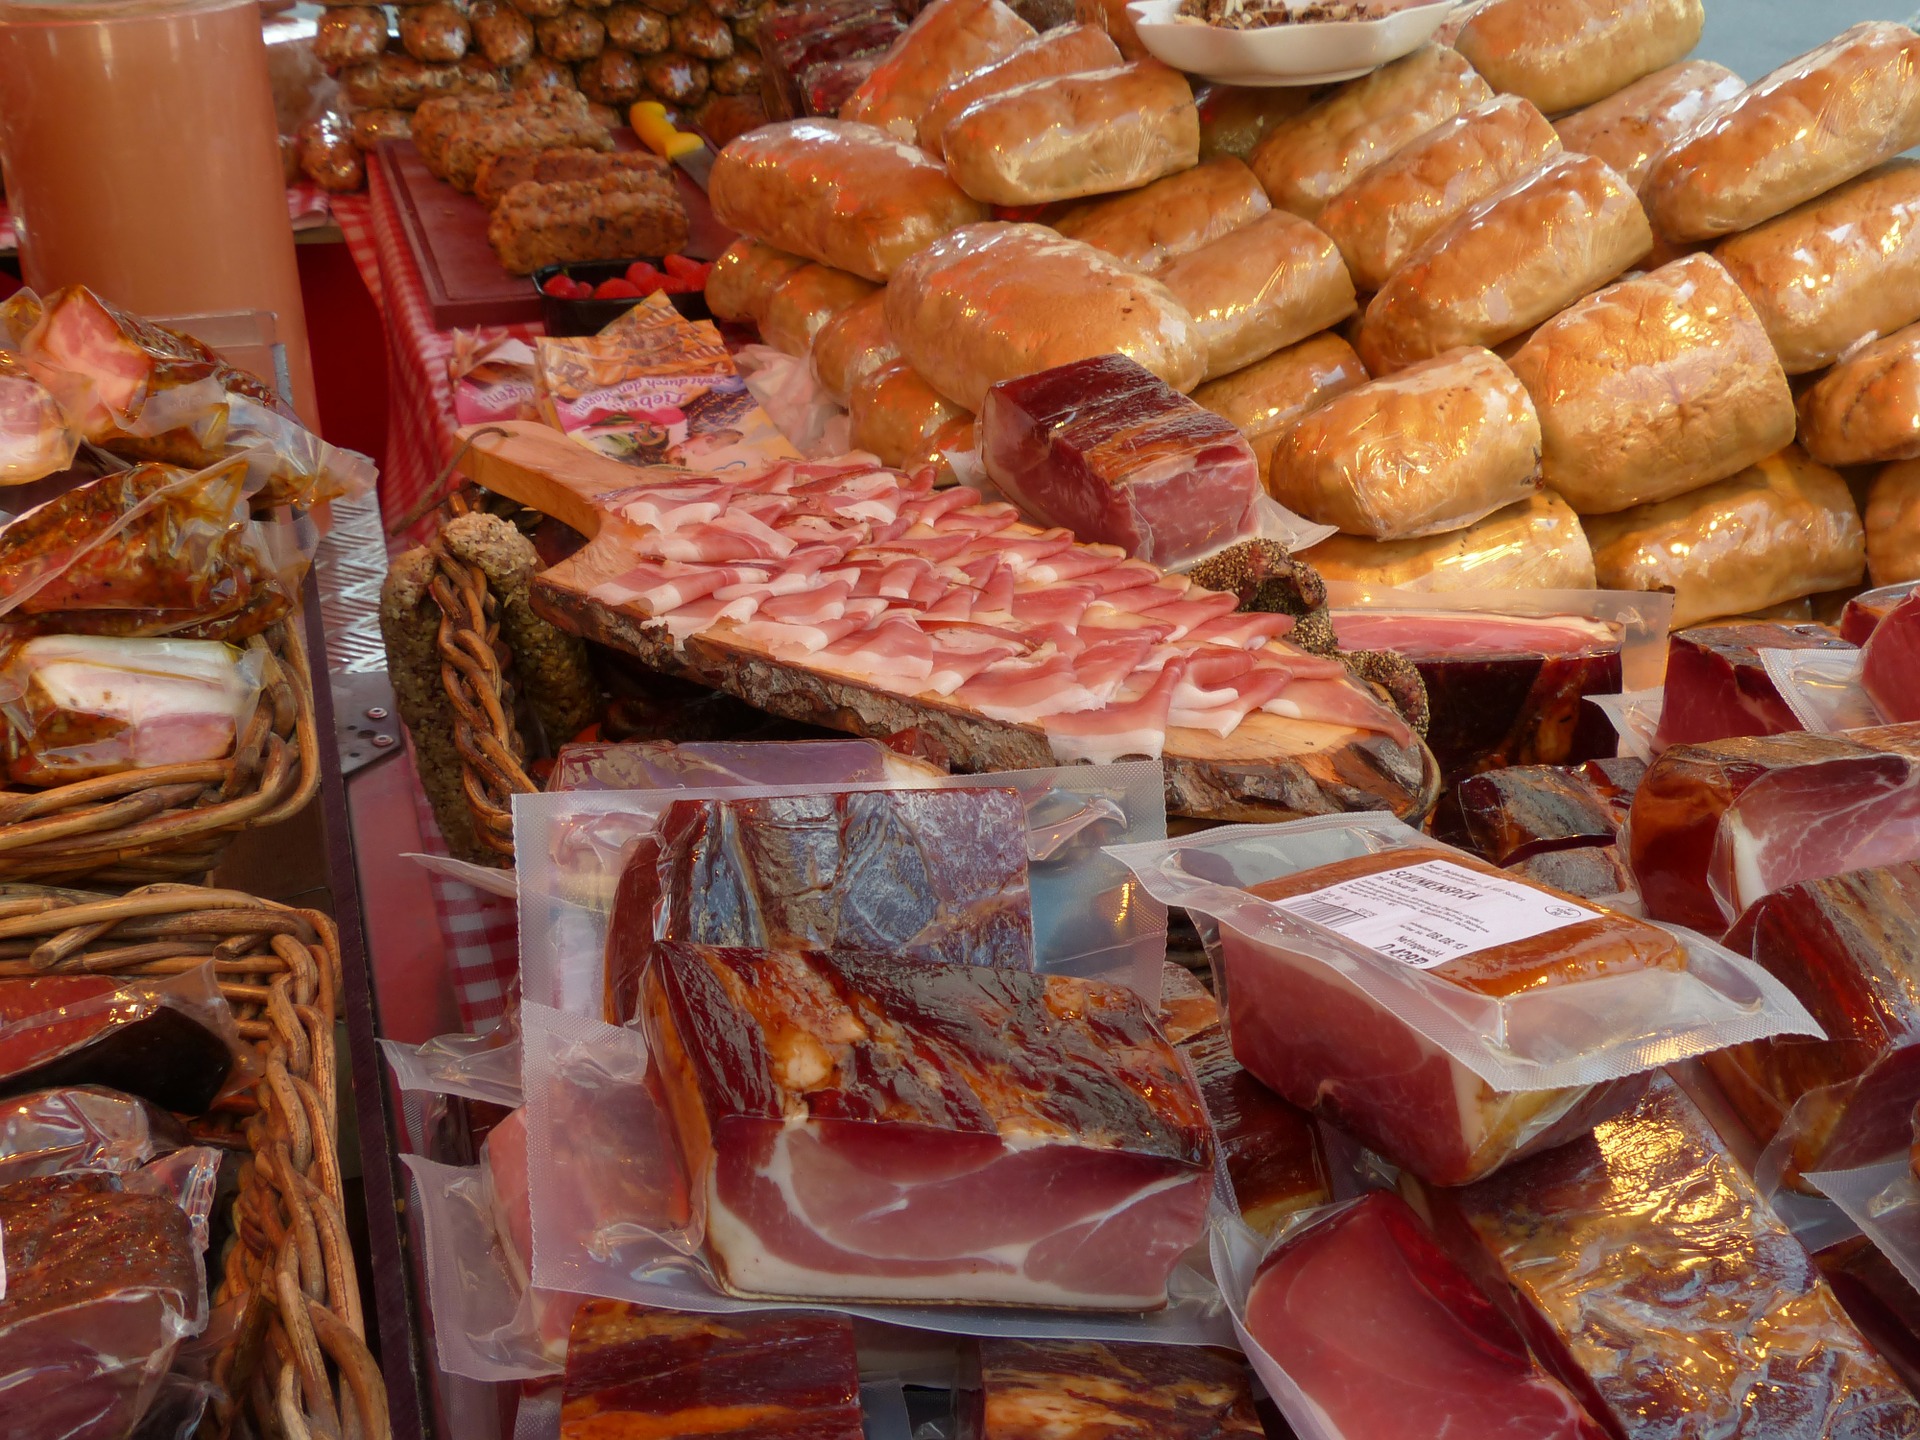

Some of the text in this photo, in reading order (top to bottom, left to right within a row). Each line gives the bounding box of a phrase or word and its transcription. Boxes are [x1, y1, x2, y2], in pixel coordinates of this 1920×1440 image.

[620, 380, 642, 394] den
[646, 378, 688, 390] durch
[1389, 871, 1483, 901] SCHINKENSPECK
[1395, 935, 1445, 958] Nettogewicht
